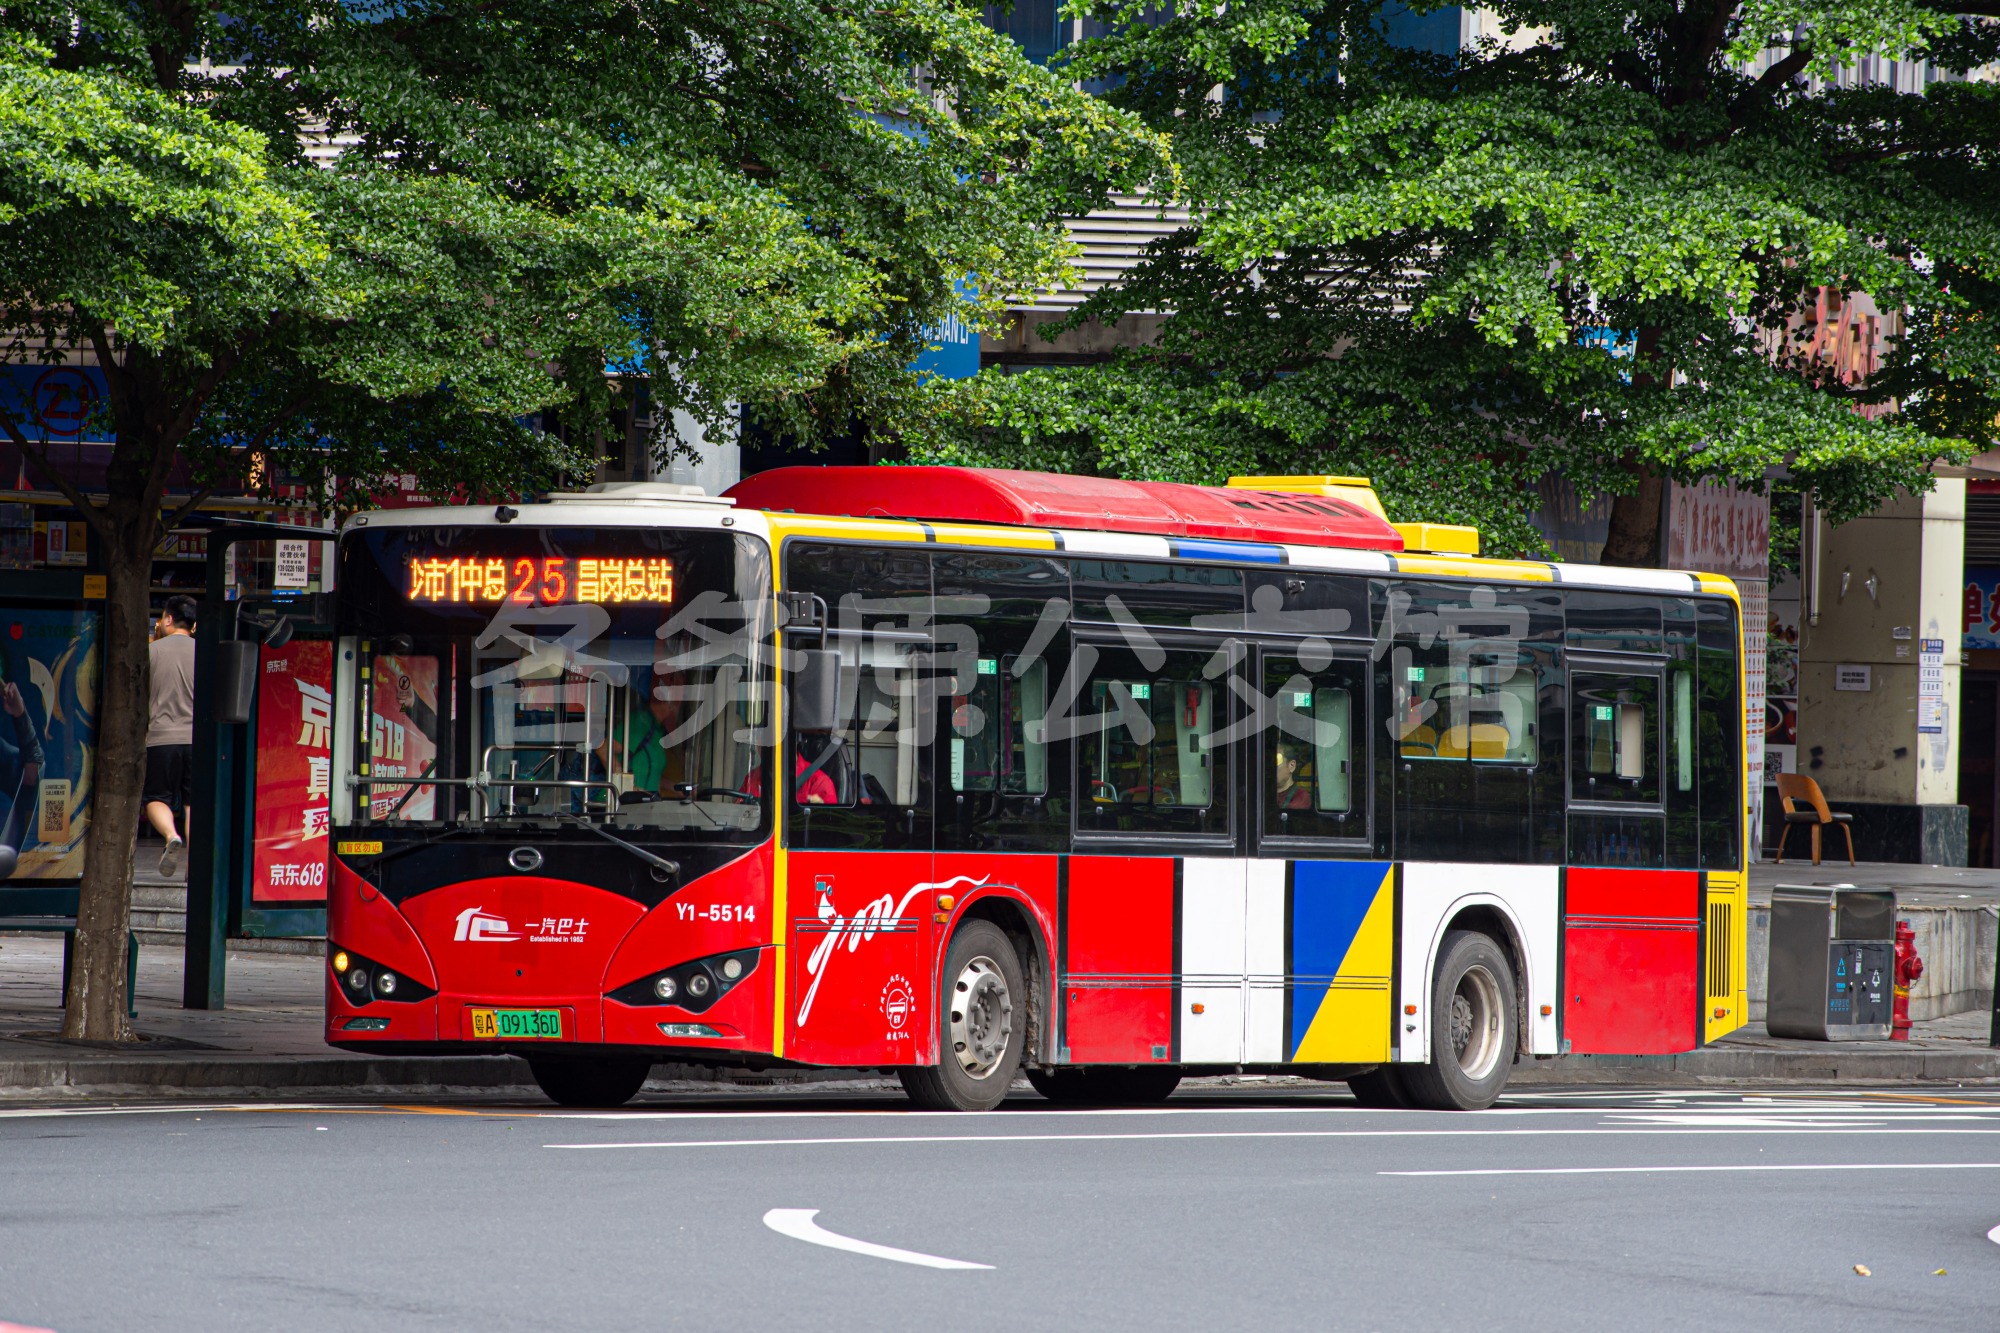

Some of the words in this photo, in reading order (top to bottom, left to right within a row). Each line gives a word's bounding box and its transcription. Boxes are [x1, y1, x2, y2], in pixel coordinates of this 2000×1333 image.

[512, 558, 569, 602] 25
[577, 558, 673, 602] 昌岗总站
[371, 712, 405, 761] 618
[346, 842, 381, 853] 盲区勿近
[269, 863, 324, 887] 京东618
[676, 902, 756, 923] Y1-5514
[525, 917, 589, 935] 一汽巴士
[530, 935, 562, 943] Established
[563, 935, 569, 943] in
[893, 1014, 901, 1024] EV
